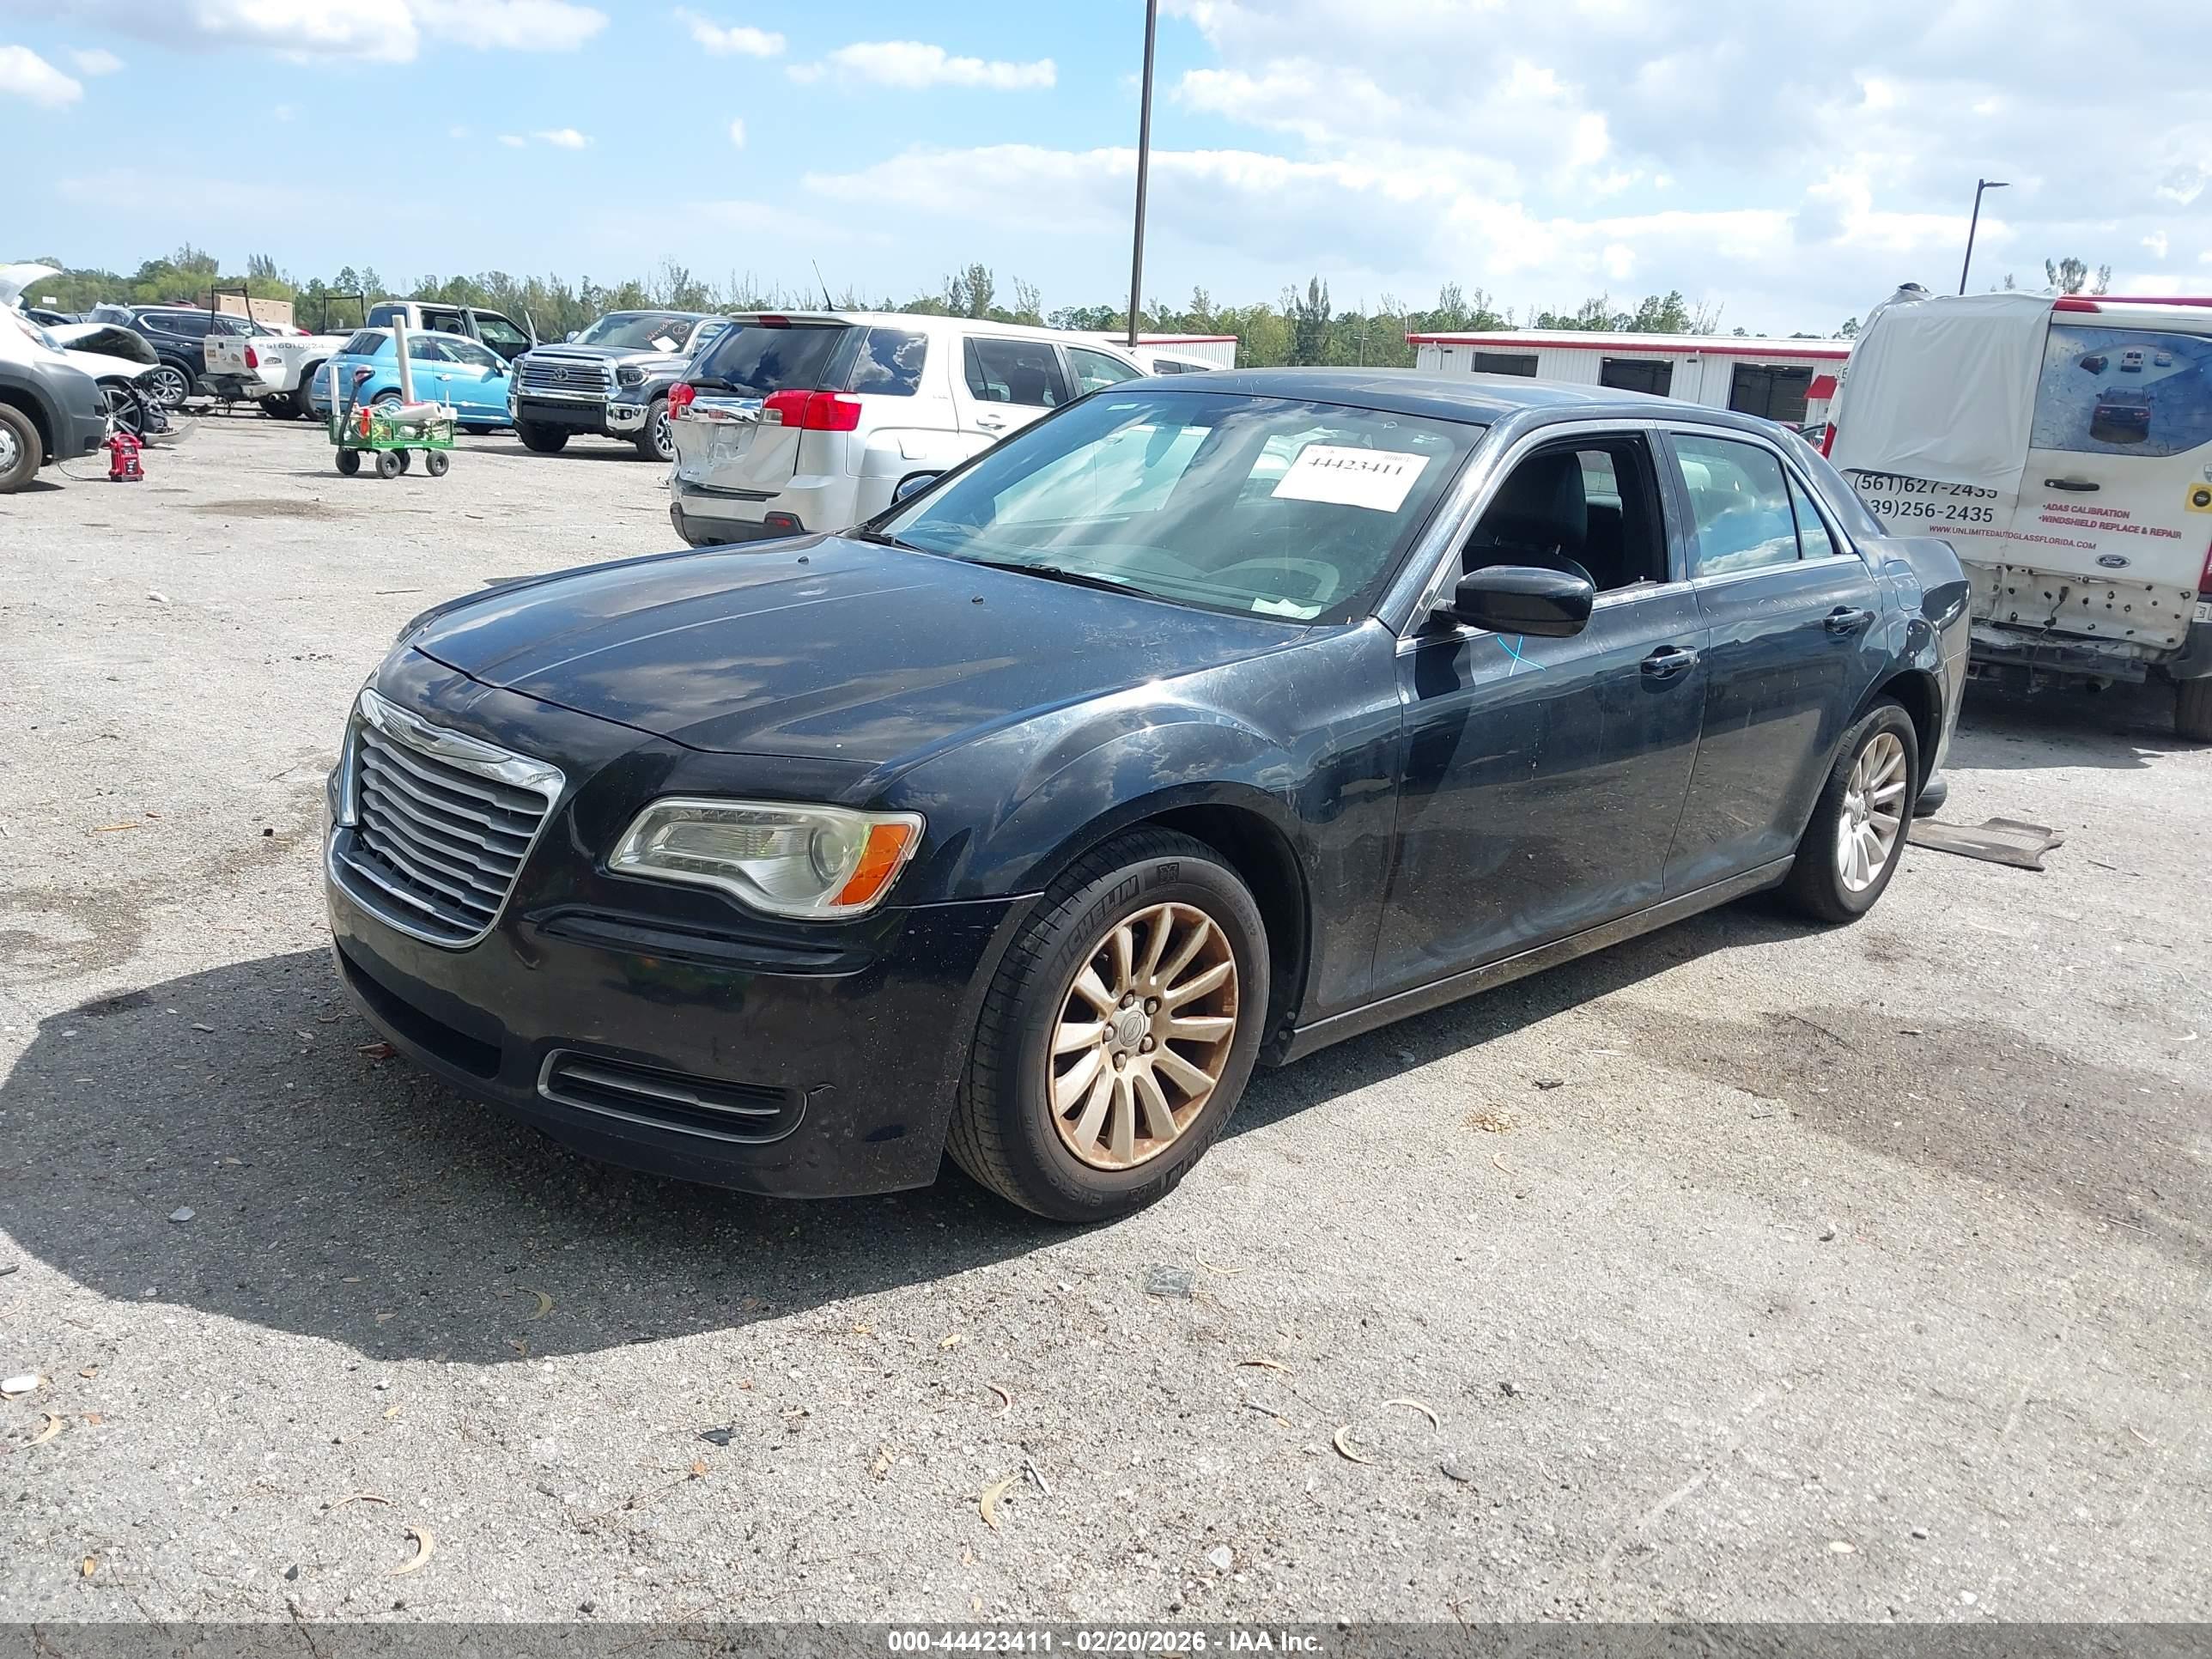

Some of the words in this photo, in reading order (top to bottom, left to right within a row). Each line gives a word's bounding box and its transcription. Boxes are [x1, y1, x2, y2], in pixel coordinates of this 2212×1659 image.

[1308, 457, 1403, 476] 44423411
[1855, 473, 1998, 498] (561)627-2435
[1864, 499, 1995, 522] 39)256-2435
[2071, 505, 2130, 519] CALIBRATION
[1929, 525, 2096, 550] WWW.UNLIMITEDAUTOGLASSFLORIDA.COM
[2041, 515, 2097, 528] WINDSHIELD
[2099, 522, 2139, 534] REPLACE
[2141, 526, 2148, 535] &
[2149, 527, 2182, 539] REPAIR
